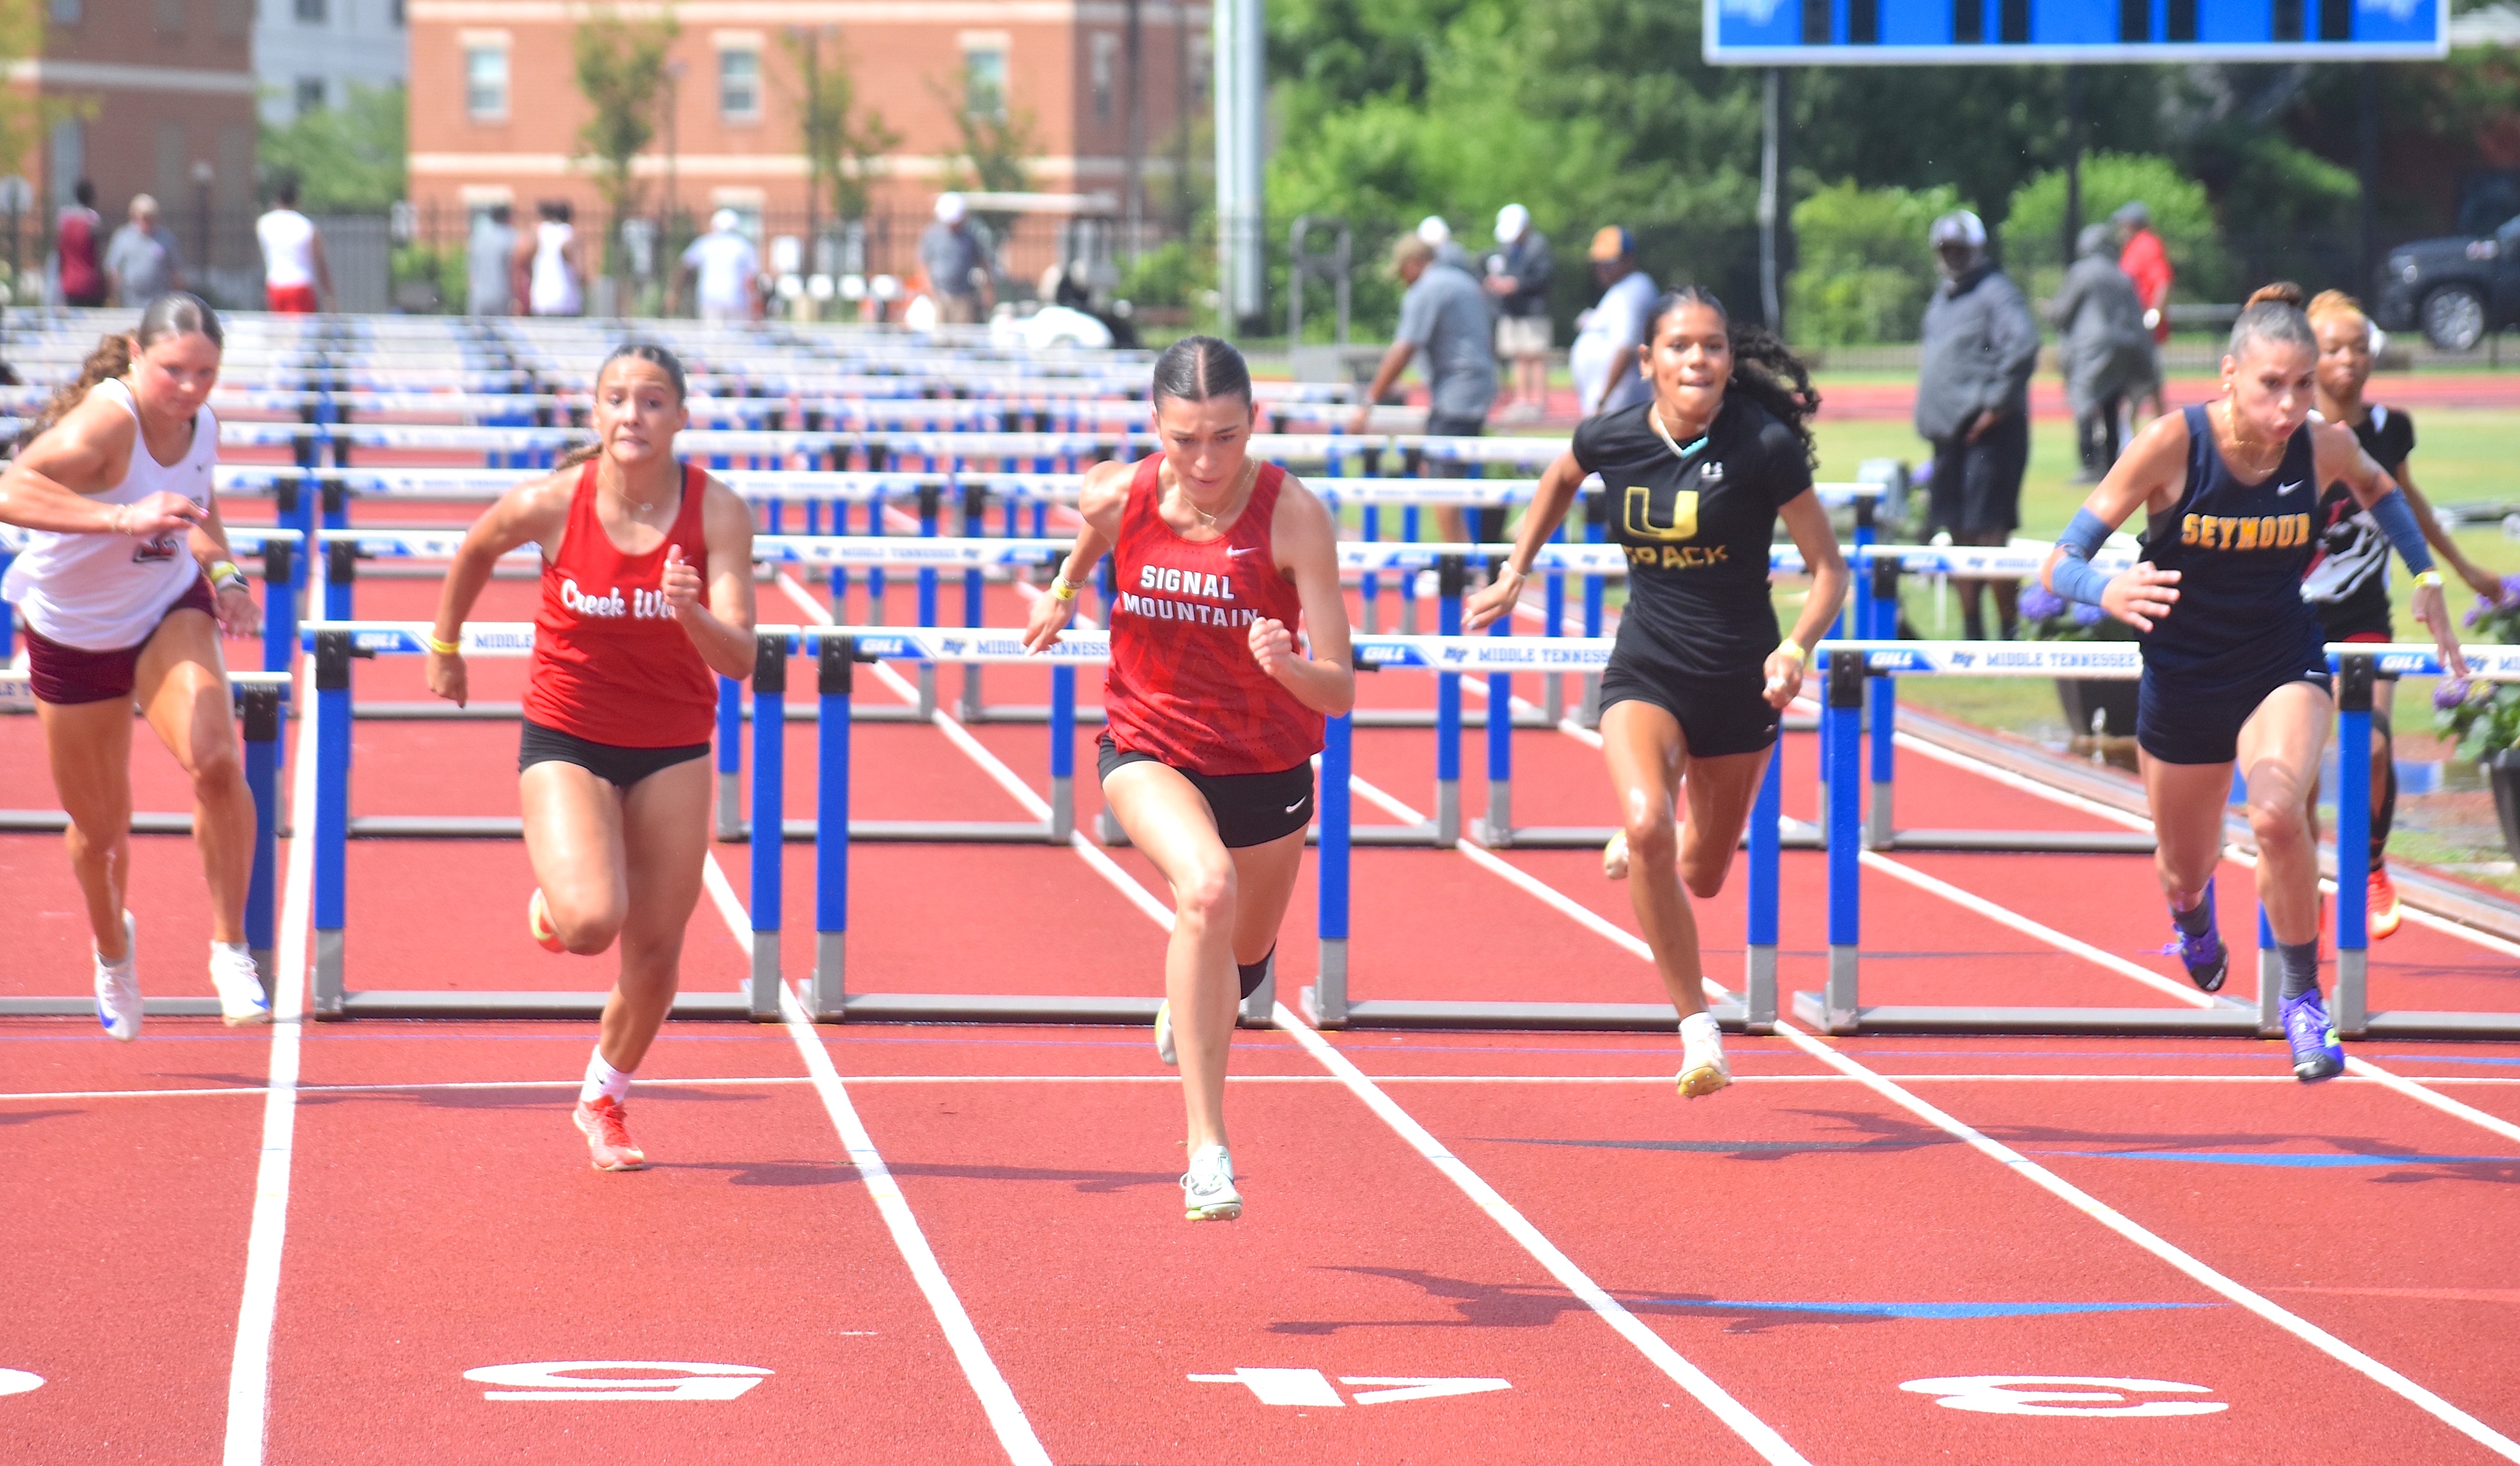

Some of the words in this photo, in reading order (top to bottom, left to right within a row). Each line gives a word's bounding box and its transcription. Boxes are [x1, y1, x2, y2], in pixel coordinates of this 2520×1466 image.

[1624, 486, 1699, 542] U
[562, 579, 625, 617] Creek
[634, 588, 673, 618] Wo
[1140, 565, 1235, 600] SIGNAL
[1122, 590, 1259, 627] MOUNTAIN
[977, 640, 1025, 655] MIDDL
[1041, 641, 1109, 655] ENNESS
[1362, 646, 1405, 662] GILL
[1479, 647, 1535, 662] MIDDLE
[1541, 649, 1610, 663] TENNESS
[1870, 651, 1914, 666] GILL
[1986, 652, 2043, 666] MIDDLE
[2049, 653, 2138, 667] TENNESSEE
[2379, 655, 2425, 671] GILL
[1186, 1367, 1513, 1407] 4
